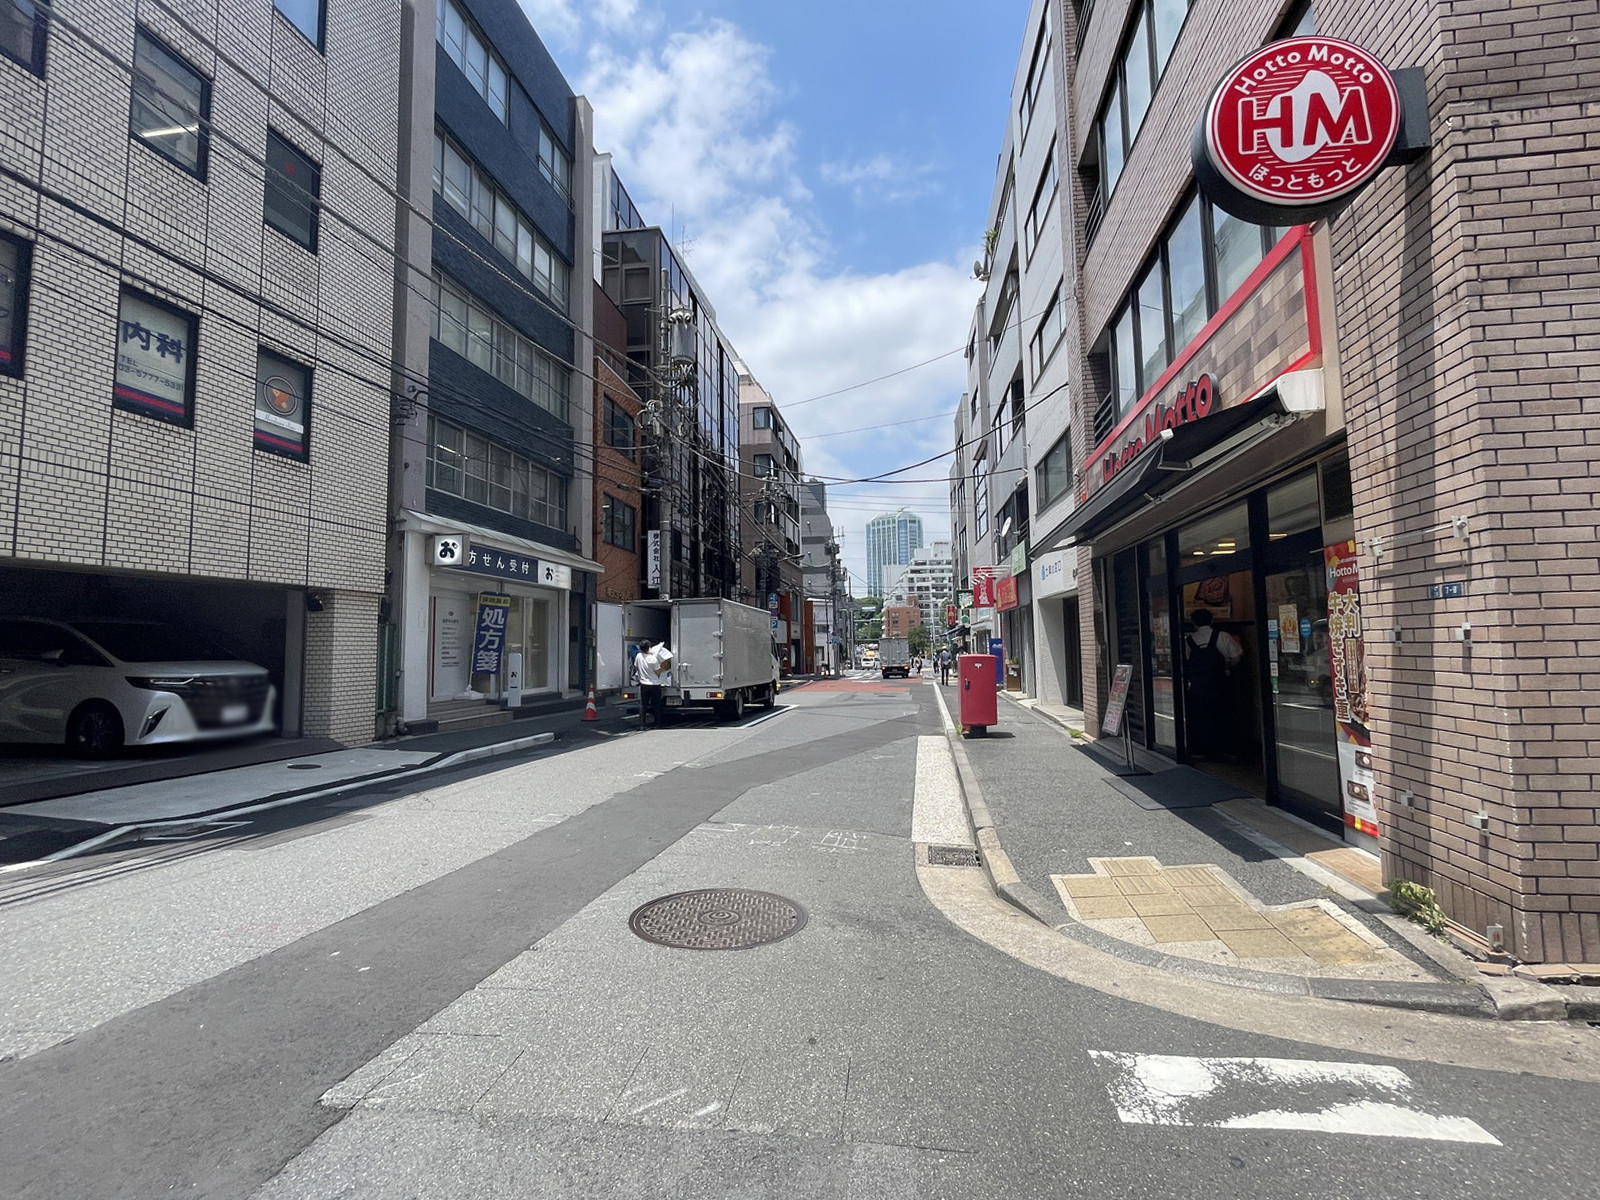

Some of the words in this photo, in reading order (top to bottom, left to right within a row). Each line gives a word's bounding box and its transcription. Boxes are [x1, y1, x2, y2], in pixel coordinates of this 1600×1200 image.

[1234, 50, 1301, 95] Hotto
[1307, 44, 1374, 84] Motto
[1248, 157, 1362, 191] ほっともっと
[120, 354, 138, 367] TEL
[122, 322, 183, 365] 内科
[1343, 588, 1360, 637] 大判
[476, 607, 505, 671] 処方箋
